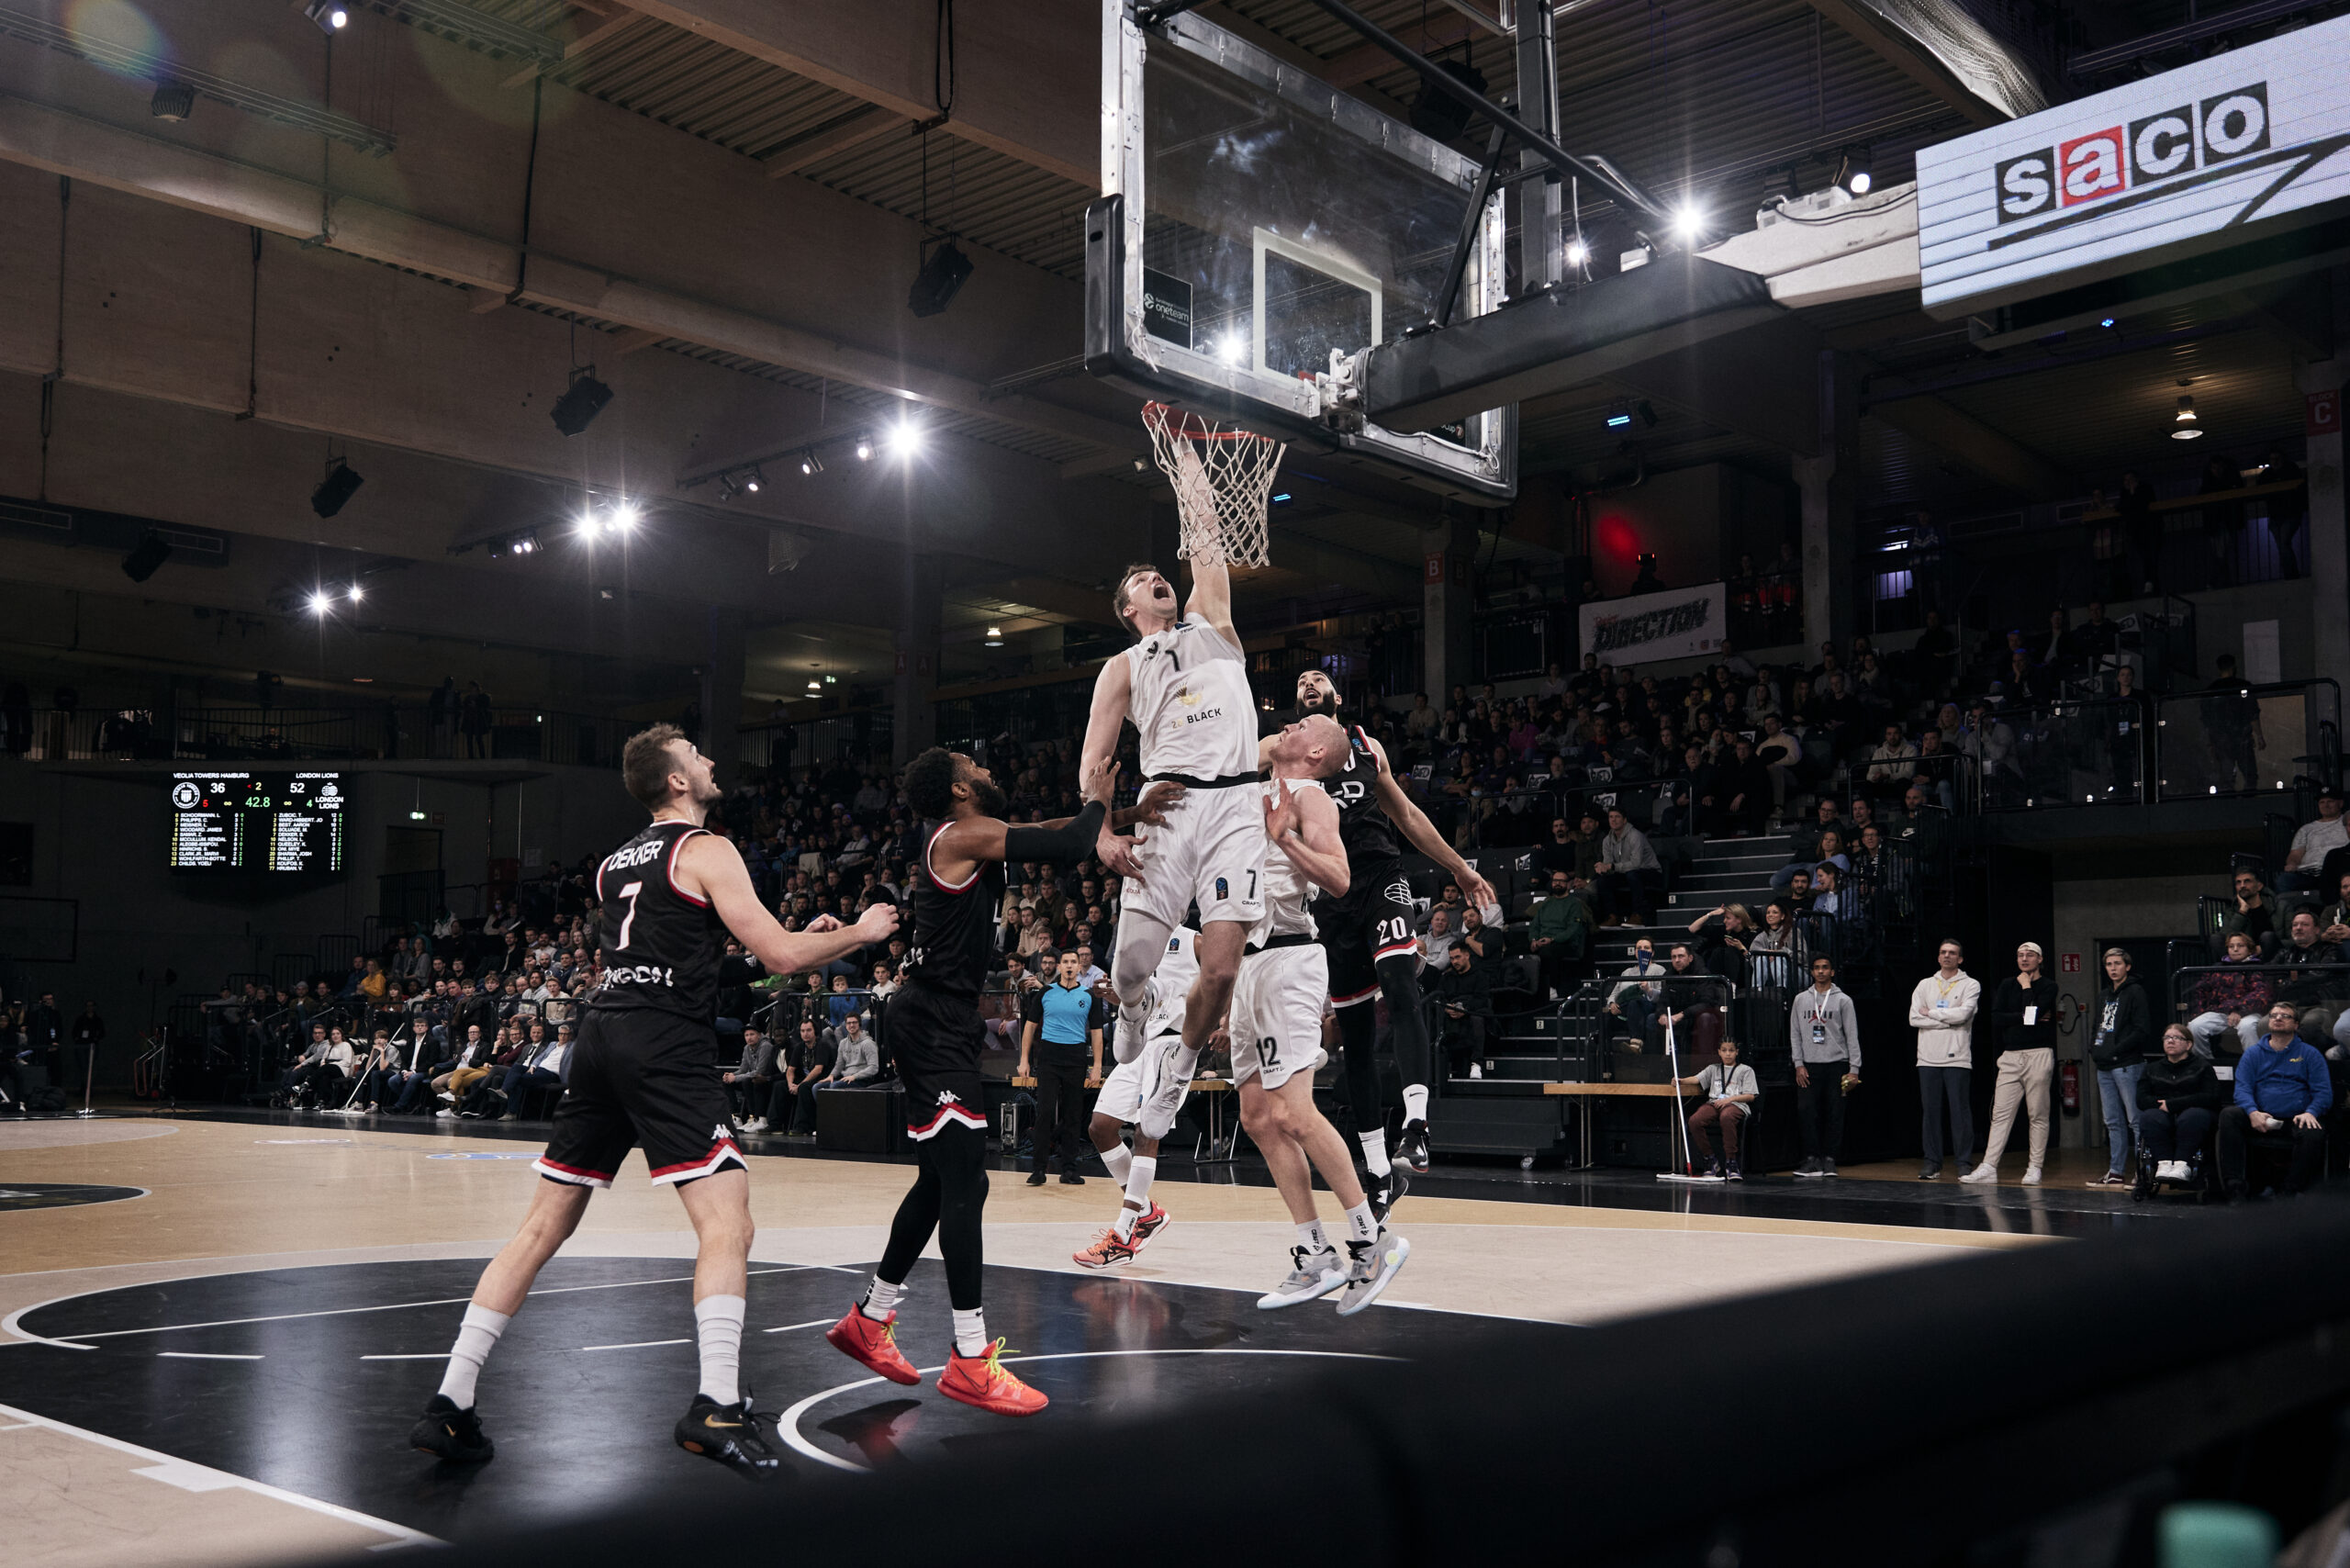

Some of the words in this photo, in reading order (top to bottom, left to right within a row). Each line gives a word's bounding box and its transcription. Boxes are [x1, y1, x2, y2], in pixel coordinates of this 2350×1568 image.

[1998, 84, 2269, 222] saco
[1156, 304, 1189, 322] oneteam
[2314, 402, 2331, 423] C
[1429, 560, 1439, 577] B
[1187, 708, 1222, 723] BLACK
[210, 782, 226, 793] 36
[255, 782, 262, 790] 2
[290, 782, 305, 793] 52
[245, 797, 270, 808] 42.8
[607, 840, 664, 871] DEKKER
[1246, 868, 1256, 900] 7
[615, 880, 643, 951] 7
[1376, 916, 1407, 946] 20
[1256, 1036, 1281, 1067] 12
[1356, 1215, 1367, 1230] CRAFT
[1311, 1228, 1320, 1245] CRAFT
